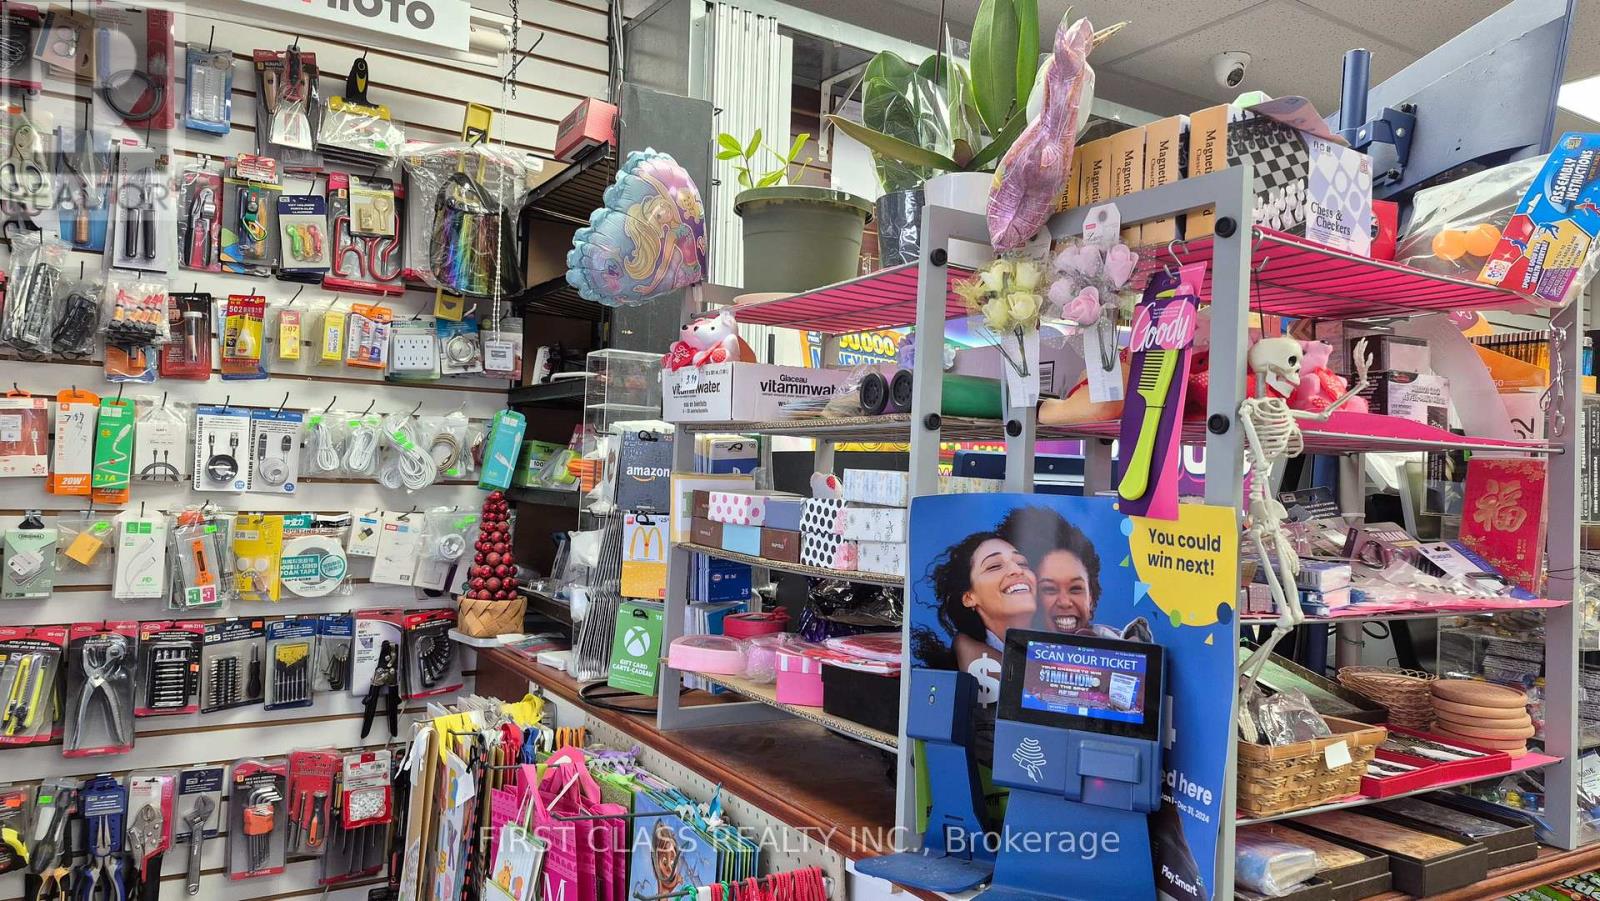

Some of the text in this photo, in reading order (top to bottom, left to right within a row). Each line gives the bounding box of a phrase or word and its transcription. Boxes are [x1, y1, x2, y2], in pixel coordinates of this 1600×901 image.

[1203, 129, 1216, 174] Magneti
[1550, 157, 1576, 204] ASSEMBLY
[1564, 149, 1594, 201] INSTRUCTIONS
[1311, 201, 1343, 222] Chess &
[1316, 215, 1351, 236] Checkers
[229, 305, 243, 313] 502
[1130, 297, 1189, 354] Goody
[760, 379, 837, 396] vitaminwat
[780, 374, 807, 384] Glaceau
[246, 460, 254, 491] CELLULAR
[626, 466, 671, 478] amazon
[1473, 479, 1528, 533] 福
[1148, 527, 1221, 553] You could
[1147, 550, 1215, 577] win next!
[619, 658, 648, 670] GIFT CARD
[1034, 649, 1065, 662] SCAN
[1067, 652, 1098, 666] YOUR
[1100, 656, 1138, 671] TICKET
[1178, 772, 1213, 806] here
[1177, 800, 1187, 812] Dec
[1195, 809, 1210, 823] 2024
[1161, 863, 1198, 897] Play Smart
